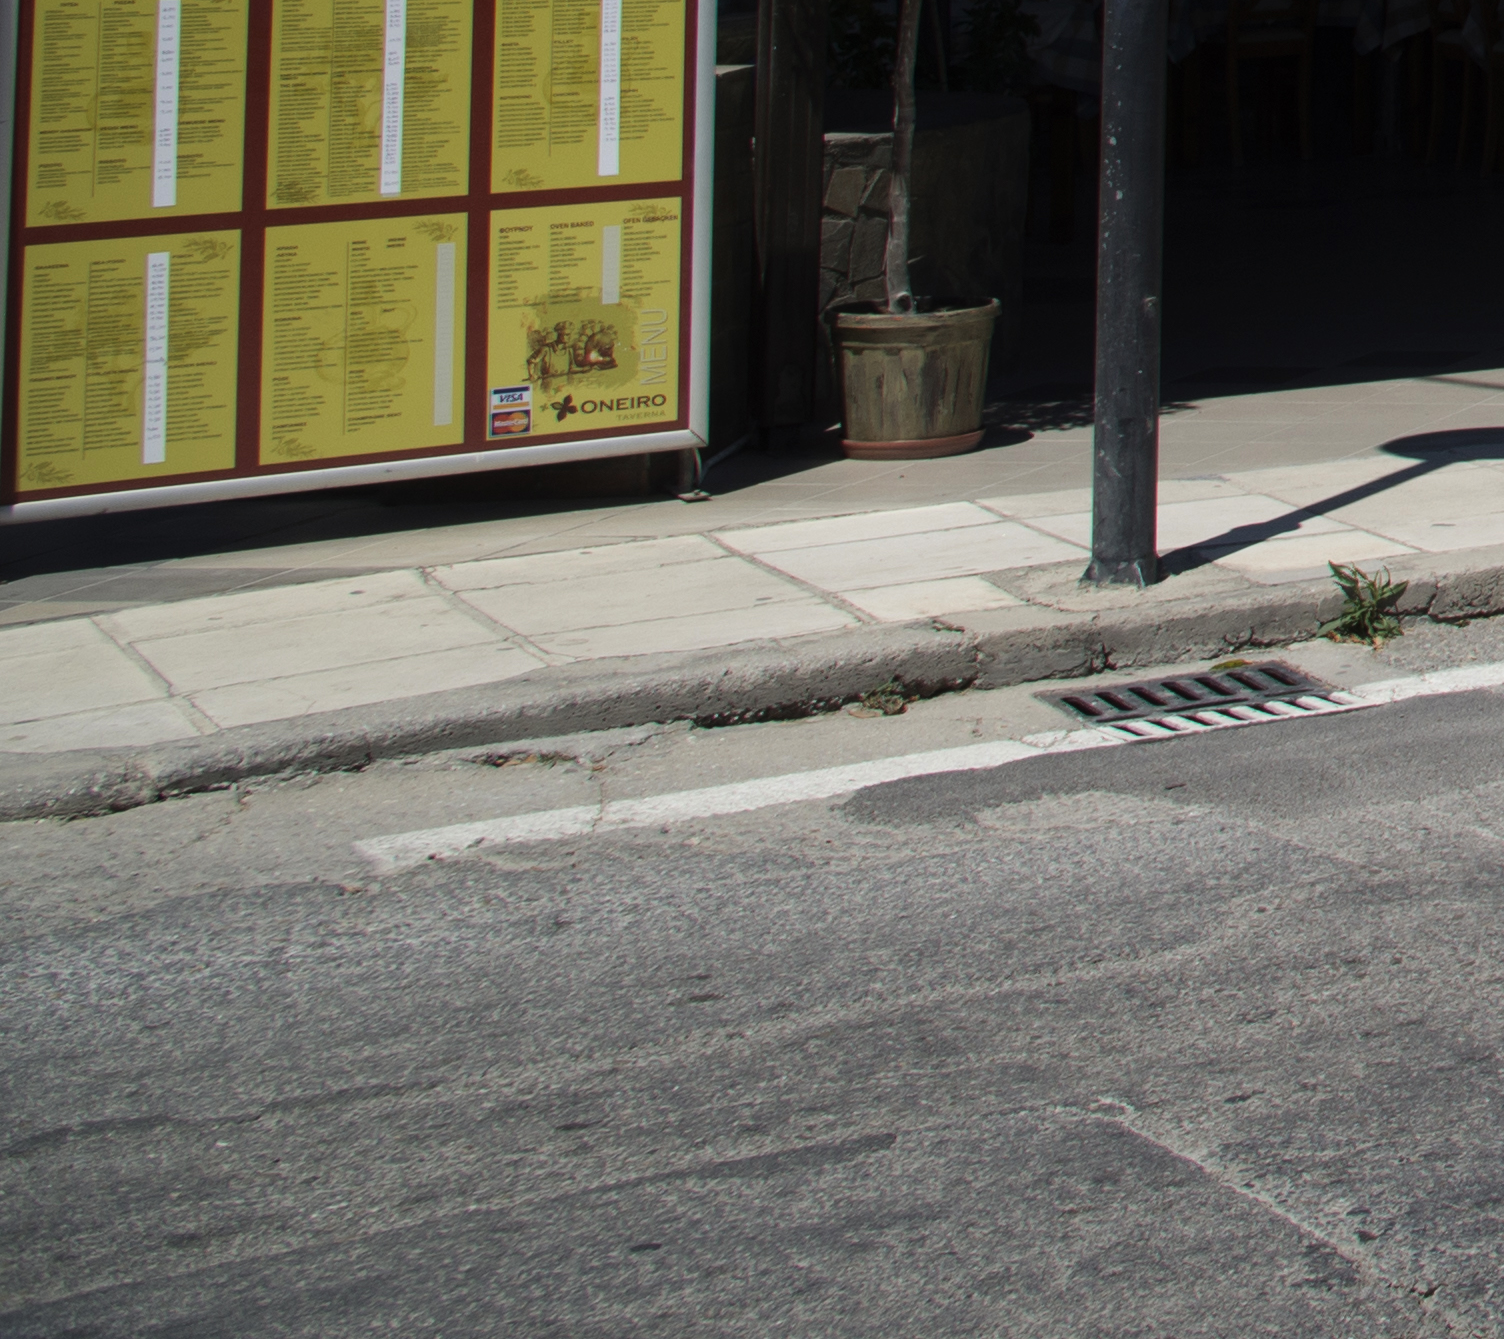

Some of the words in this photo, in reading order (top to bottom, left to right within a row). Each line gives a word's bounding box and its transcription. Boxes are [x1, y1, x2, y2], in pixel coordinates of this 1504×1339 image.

[640, 308, 668, 386] MENU
[499, 392, 524, 403] VISA
[581, 393, 668, 414] ONEIRO
[616, 409, 667, 422] TAVERNA
